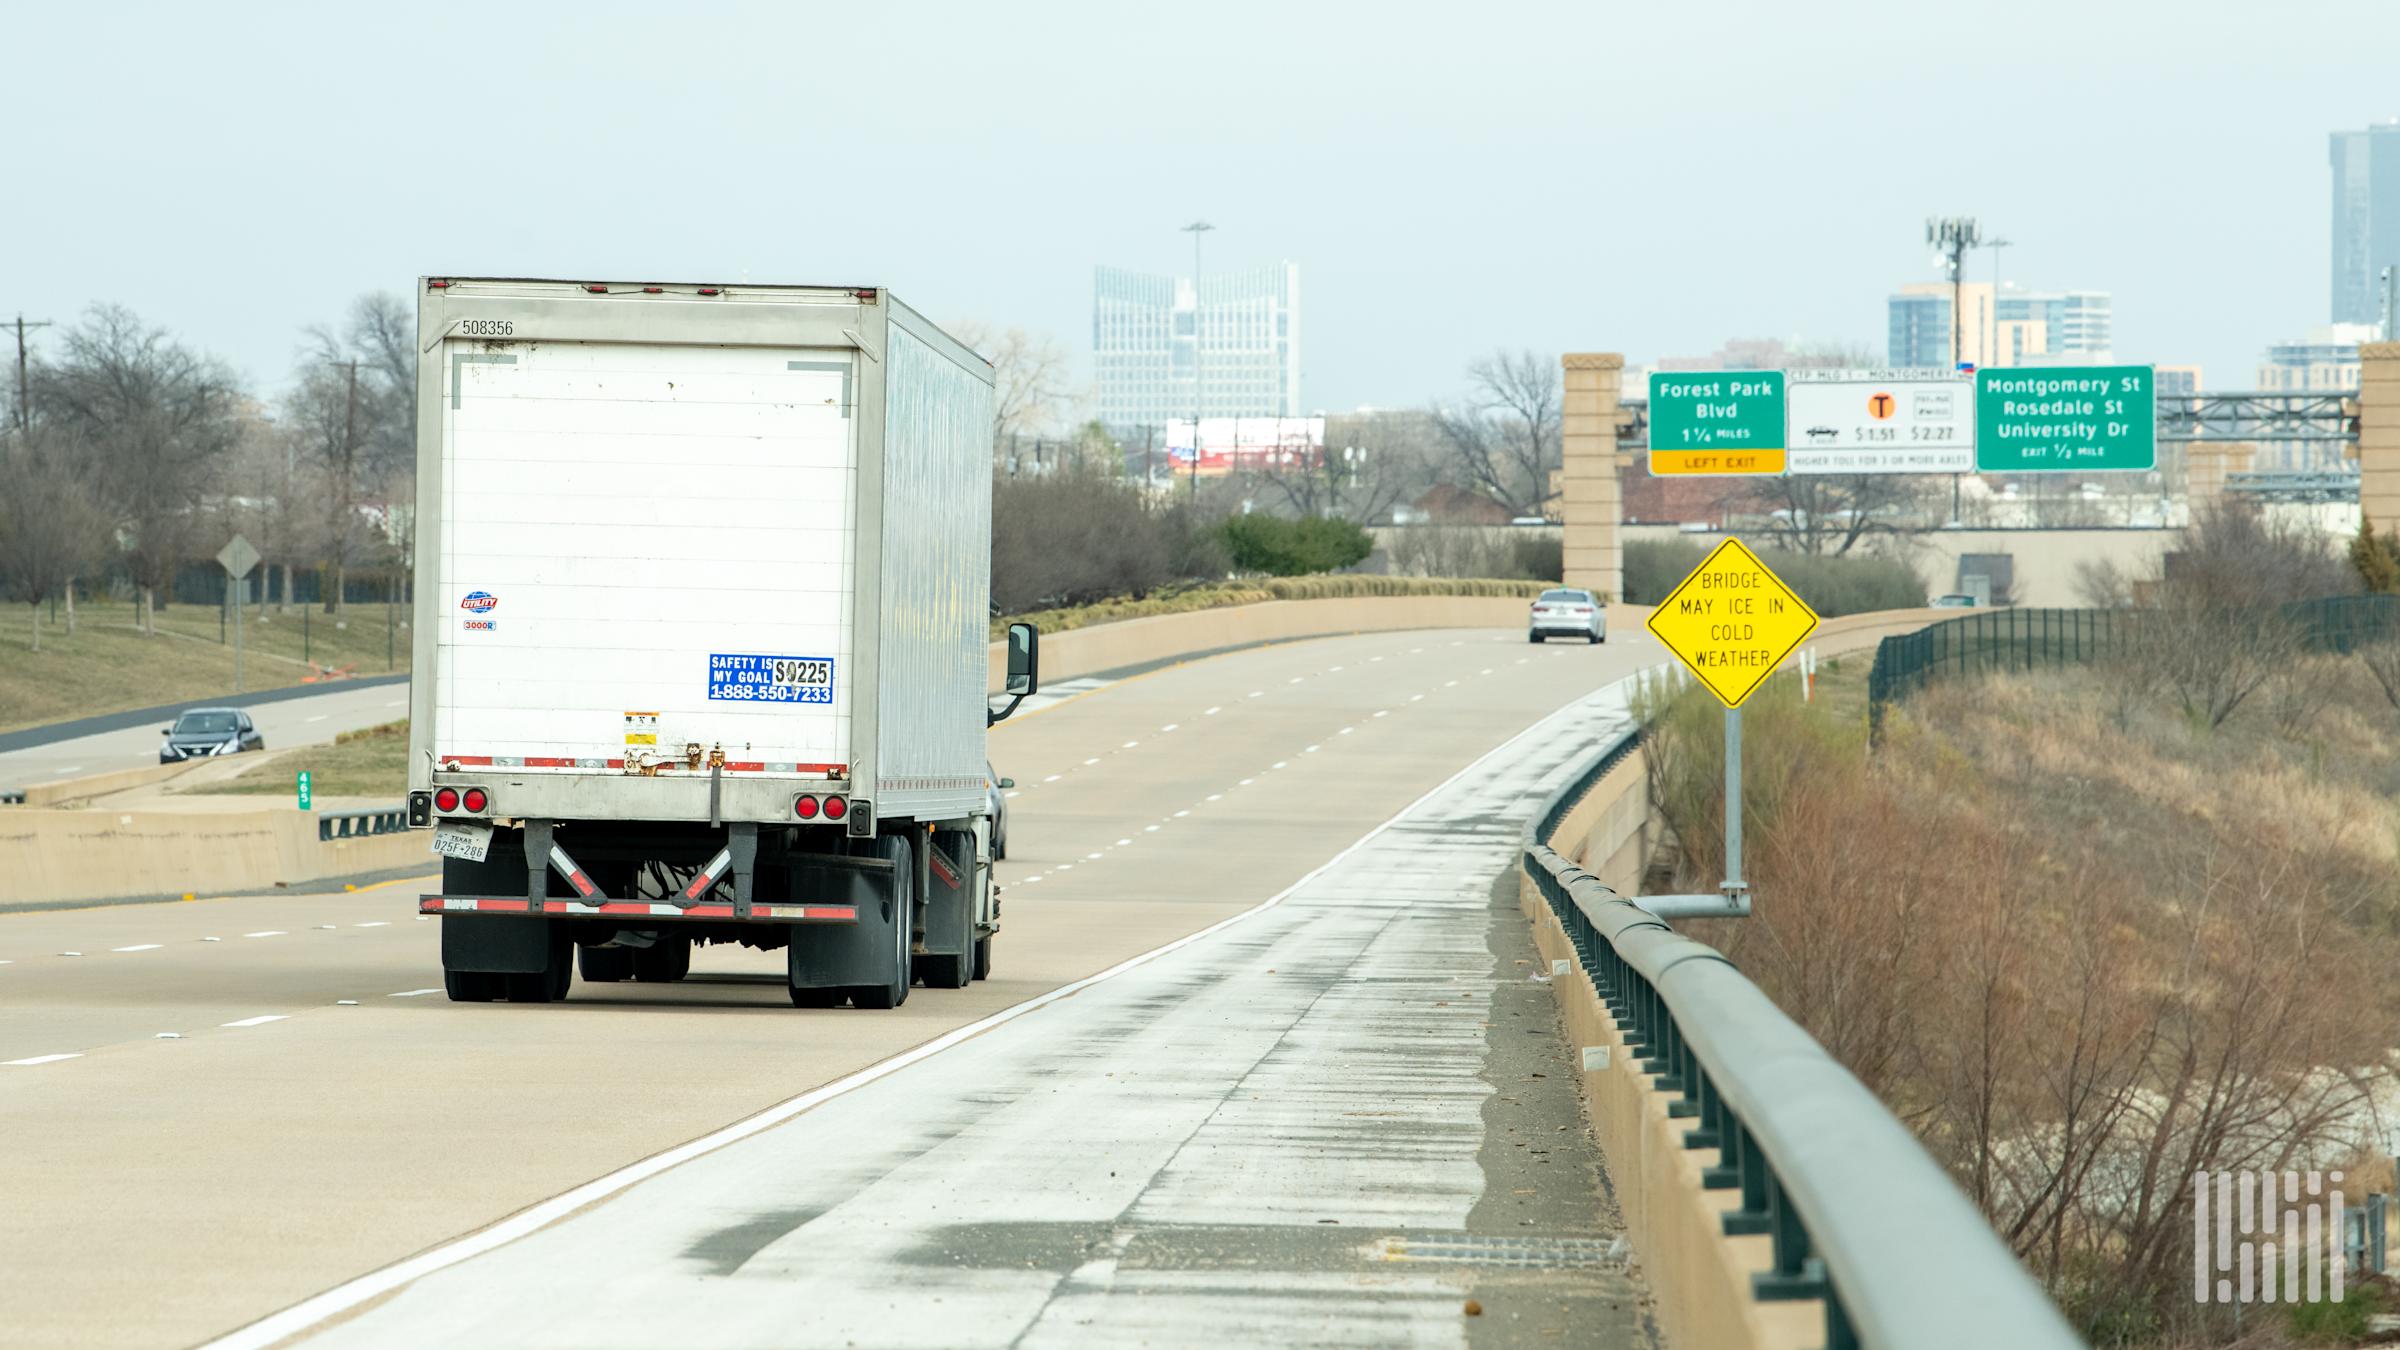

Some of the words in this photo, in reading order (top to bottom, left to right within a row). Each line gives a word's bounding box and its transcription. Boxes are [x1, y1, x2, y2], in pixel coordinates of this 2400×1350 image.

[463, 320, 513, 336] 508356
[1869, 368, 1951, 379] MONTGOMERY
[1660, 382, 1720, 398] Forest
[1730, 380, 1772, 397] Park
[1987, 377, 2111, 397] Montgomery
[2121, 376, 2141, 392] St
[1696, 402, 1737, 418] Blvd
[2003, 400, 2094, 416] Rosedale
[2104, 399, 2124, 414] St
[1716, 428, 1751, 439] MILES
[1998, 421, 2097, 440] University
[2107, 421, 2129, 437] Dr
[2022, 447, 2047, 458] EXIT
[2077, 446, 2105, 457] MILE
[1685, 458, 1718, 469] LEFT
[1726, 457, 1755, 468] EXIT
[1702, 573, 1761, 589] BRIDGE
[463, 599, 496, 608] UTILITY
[1680, 600, 1713, 615] MAY
[1729, 599, 1753, 614] ICE
[1769, 599, 1784, 614] IN
[1711, 625, 1754, 641] COLD
[711, 656, 757, 670] SAFETY
[761, 658, 773, 670] IS
[1696, 651, 1770, 667] WEATHER
[713, 671, 732, 682] MY
[738, 671, 770, 684] GOAL
[775, 661, 828, 684] S0225
[710, 684, 831, 702] 1-888-550-7233
[451, 835, 473, 844] TEXAS
